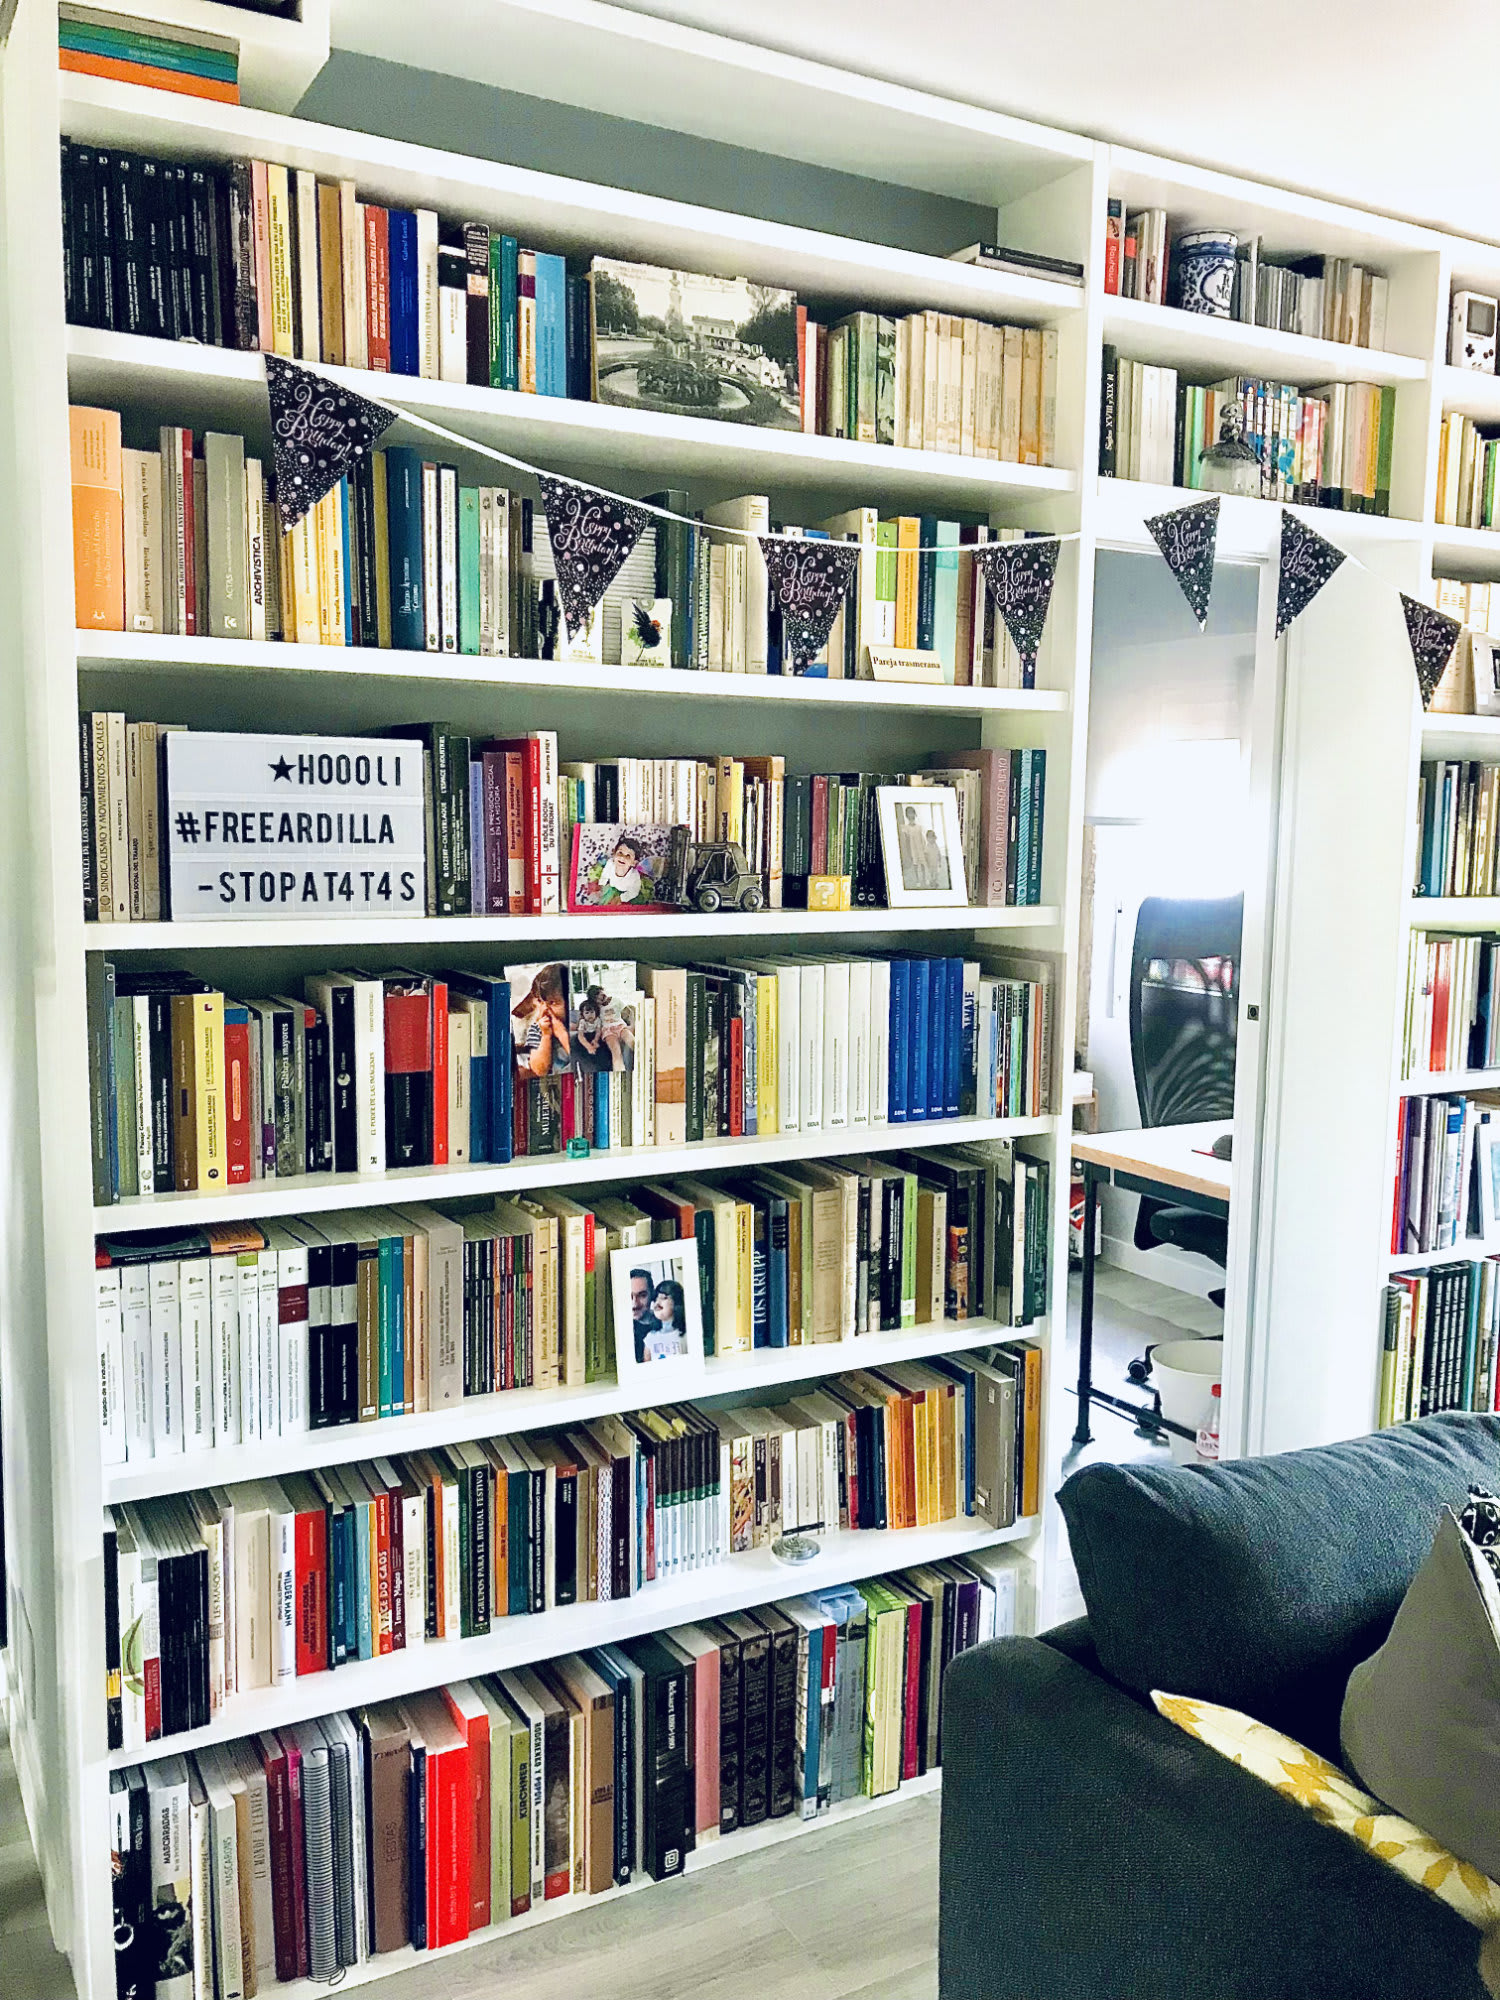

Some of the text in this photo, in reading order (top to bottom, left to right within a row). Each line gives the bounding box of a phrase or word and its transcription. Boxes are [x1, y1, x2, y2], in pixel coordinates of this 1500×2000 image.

[95, 720, 105, 762] SOCIALES
[98, 763, 107, 823] MOVIMIENTOS
[487, 764, 495, 790] SOCIAL
[174, 810, 395, 844] #FREEARDILLA
[994, 757, 1007, 872] SOLIDARIDAD DESDE ABAJO
[100, 831, 110, 893] SINDICALISMO
[543, 844, 549, 852] LE
[549, 838, 555, 848] DU
[281, 1023, 290, 1056] mayores
[540, 1091, 551, 1136] MUJERES
[753, 1249, 767, 1296] KRUPP
[378, 1550, 388, 1579] CAOS
[476, 1542, 484, 1553] EL
[476, 1554, 484, 1577] PARA
[476, 1578, 485, 1614] GRUPOS
[518, 1762, 529, 1819] KIRCHNER
[162, 1806, 171, 1864] MASCARADAS
[222, 1836, 233, 1886] MASCARONS
